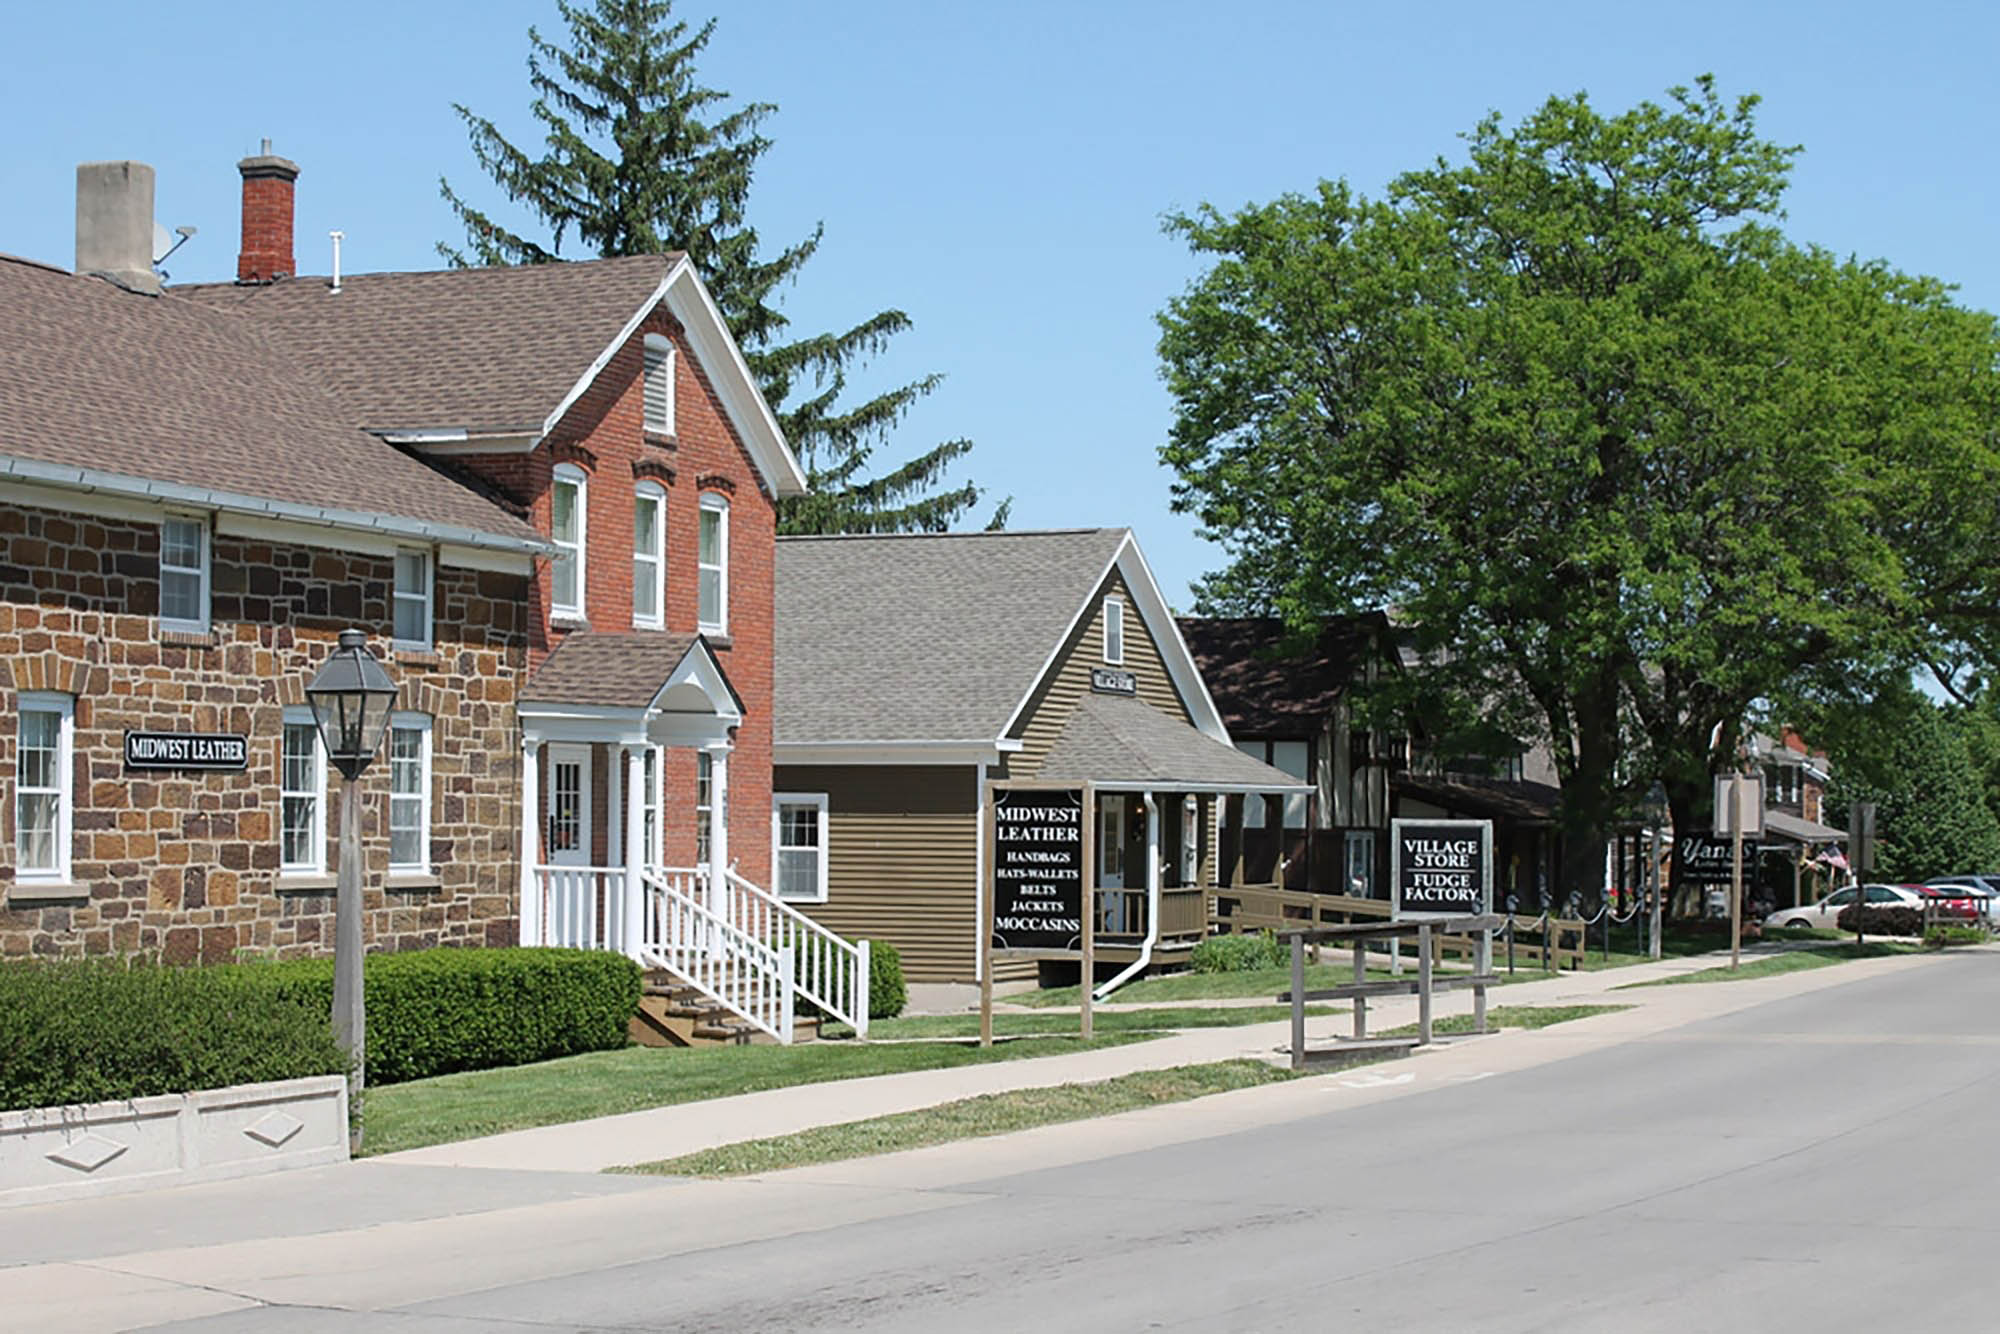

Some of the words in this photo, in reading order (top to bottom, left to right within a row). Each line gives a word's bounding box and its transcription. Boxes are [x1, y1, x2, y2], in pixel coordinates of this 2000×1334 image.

[131, 738, 189, 759] MIDWEST
[192, 740, 244, 760] LEATHER
[997, 807, 1080, 822] MIDWEST
[998, 827, 1079, 841] LEATHER
[1405, 840, 1478, 854] VILLAGE
[1007, 852, 1071, 862] HANDBAGS
[1414, 854, 1470, 867] STORE
[997, 868, 1079, 880] HATS-WALLETS
[1414, 874, 1471, 888] FUDGE
[1020, 885, 1057, 895] BELTS
[1405, 887, 1479, 901] FACTORY
[1011, 901, 1064, 912] JACKETS
[996, 917, 1080, 931] MOCCASINS
